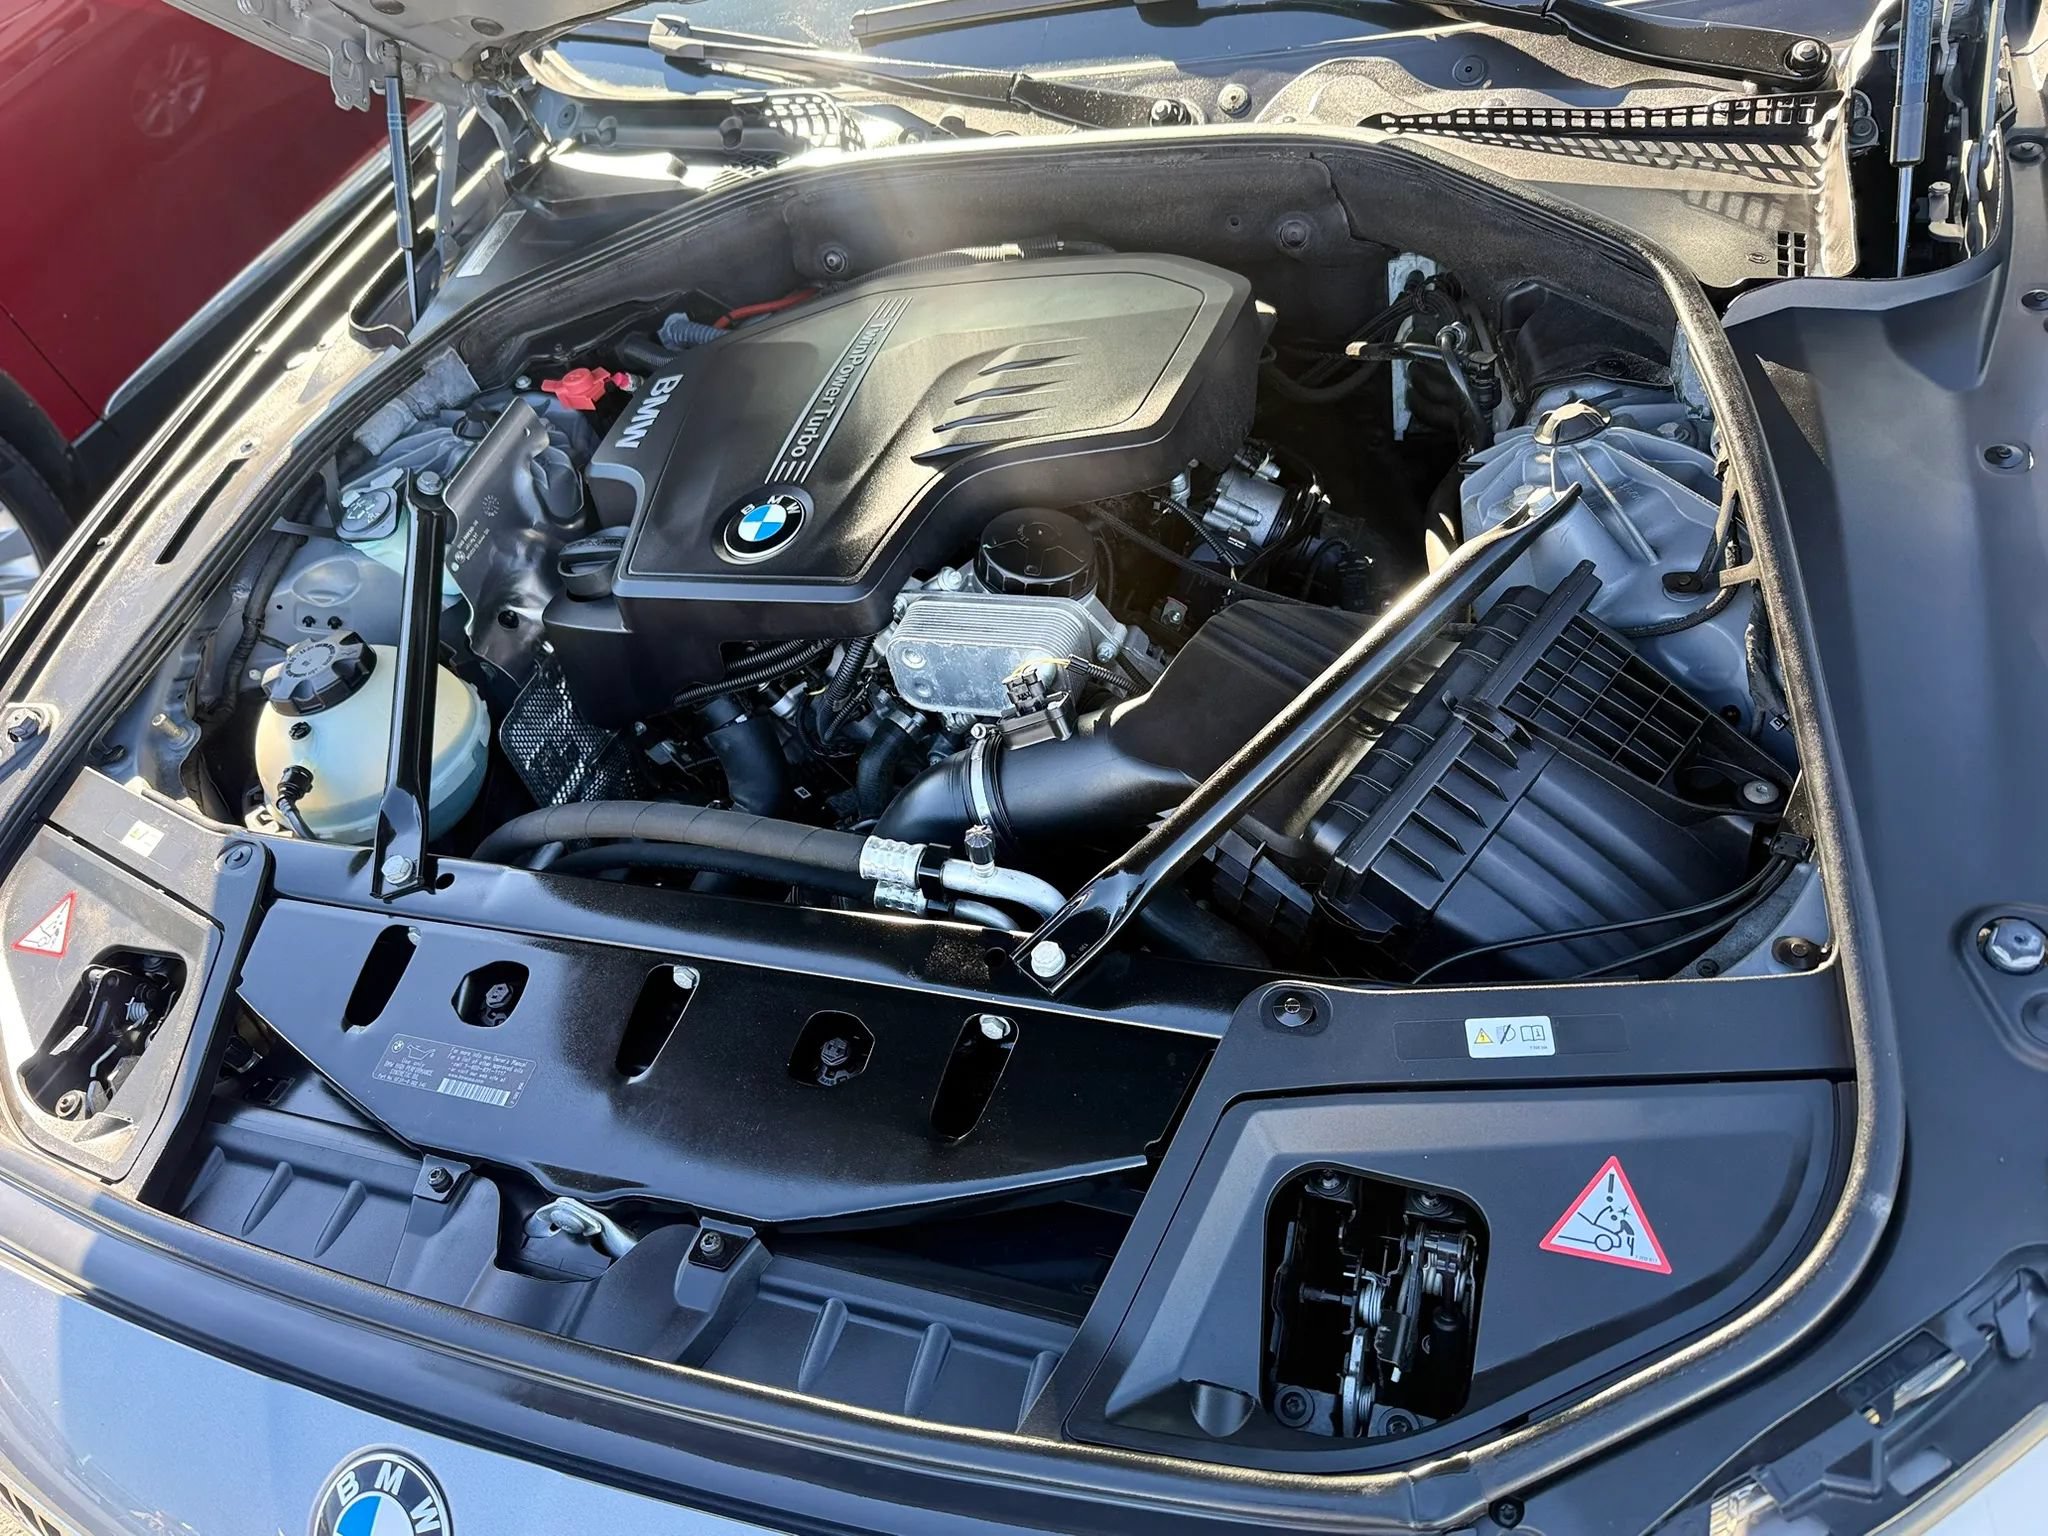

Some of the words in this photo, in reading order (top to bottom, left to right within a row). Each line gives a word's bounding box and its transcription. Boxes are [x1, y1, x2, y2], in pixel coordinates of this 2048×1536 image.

[615, 373, 684, 449] BMW
[740, 495, 801, 516] BMW
[336, 1460, 442, 1535] BMW
